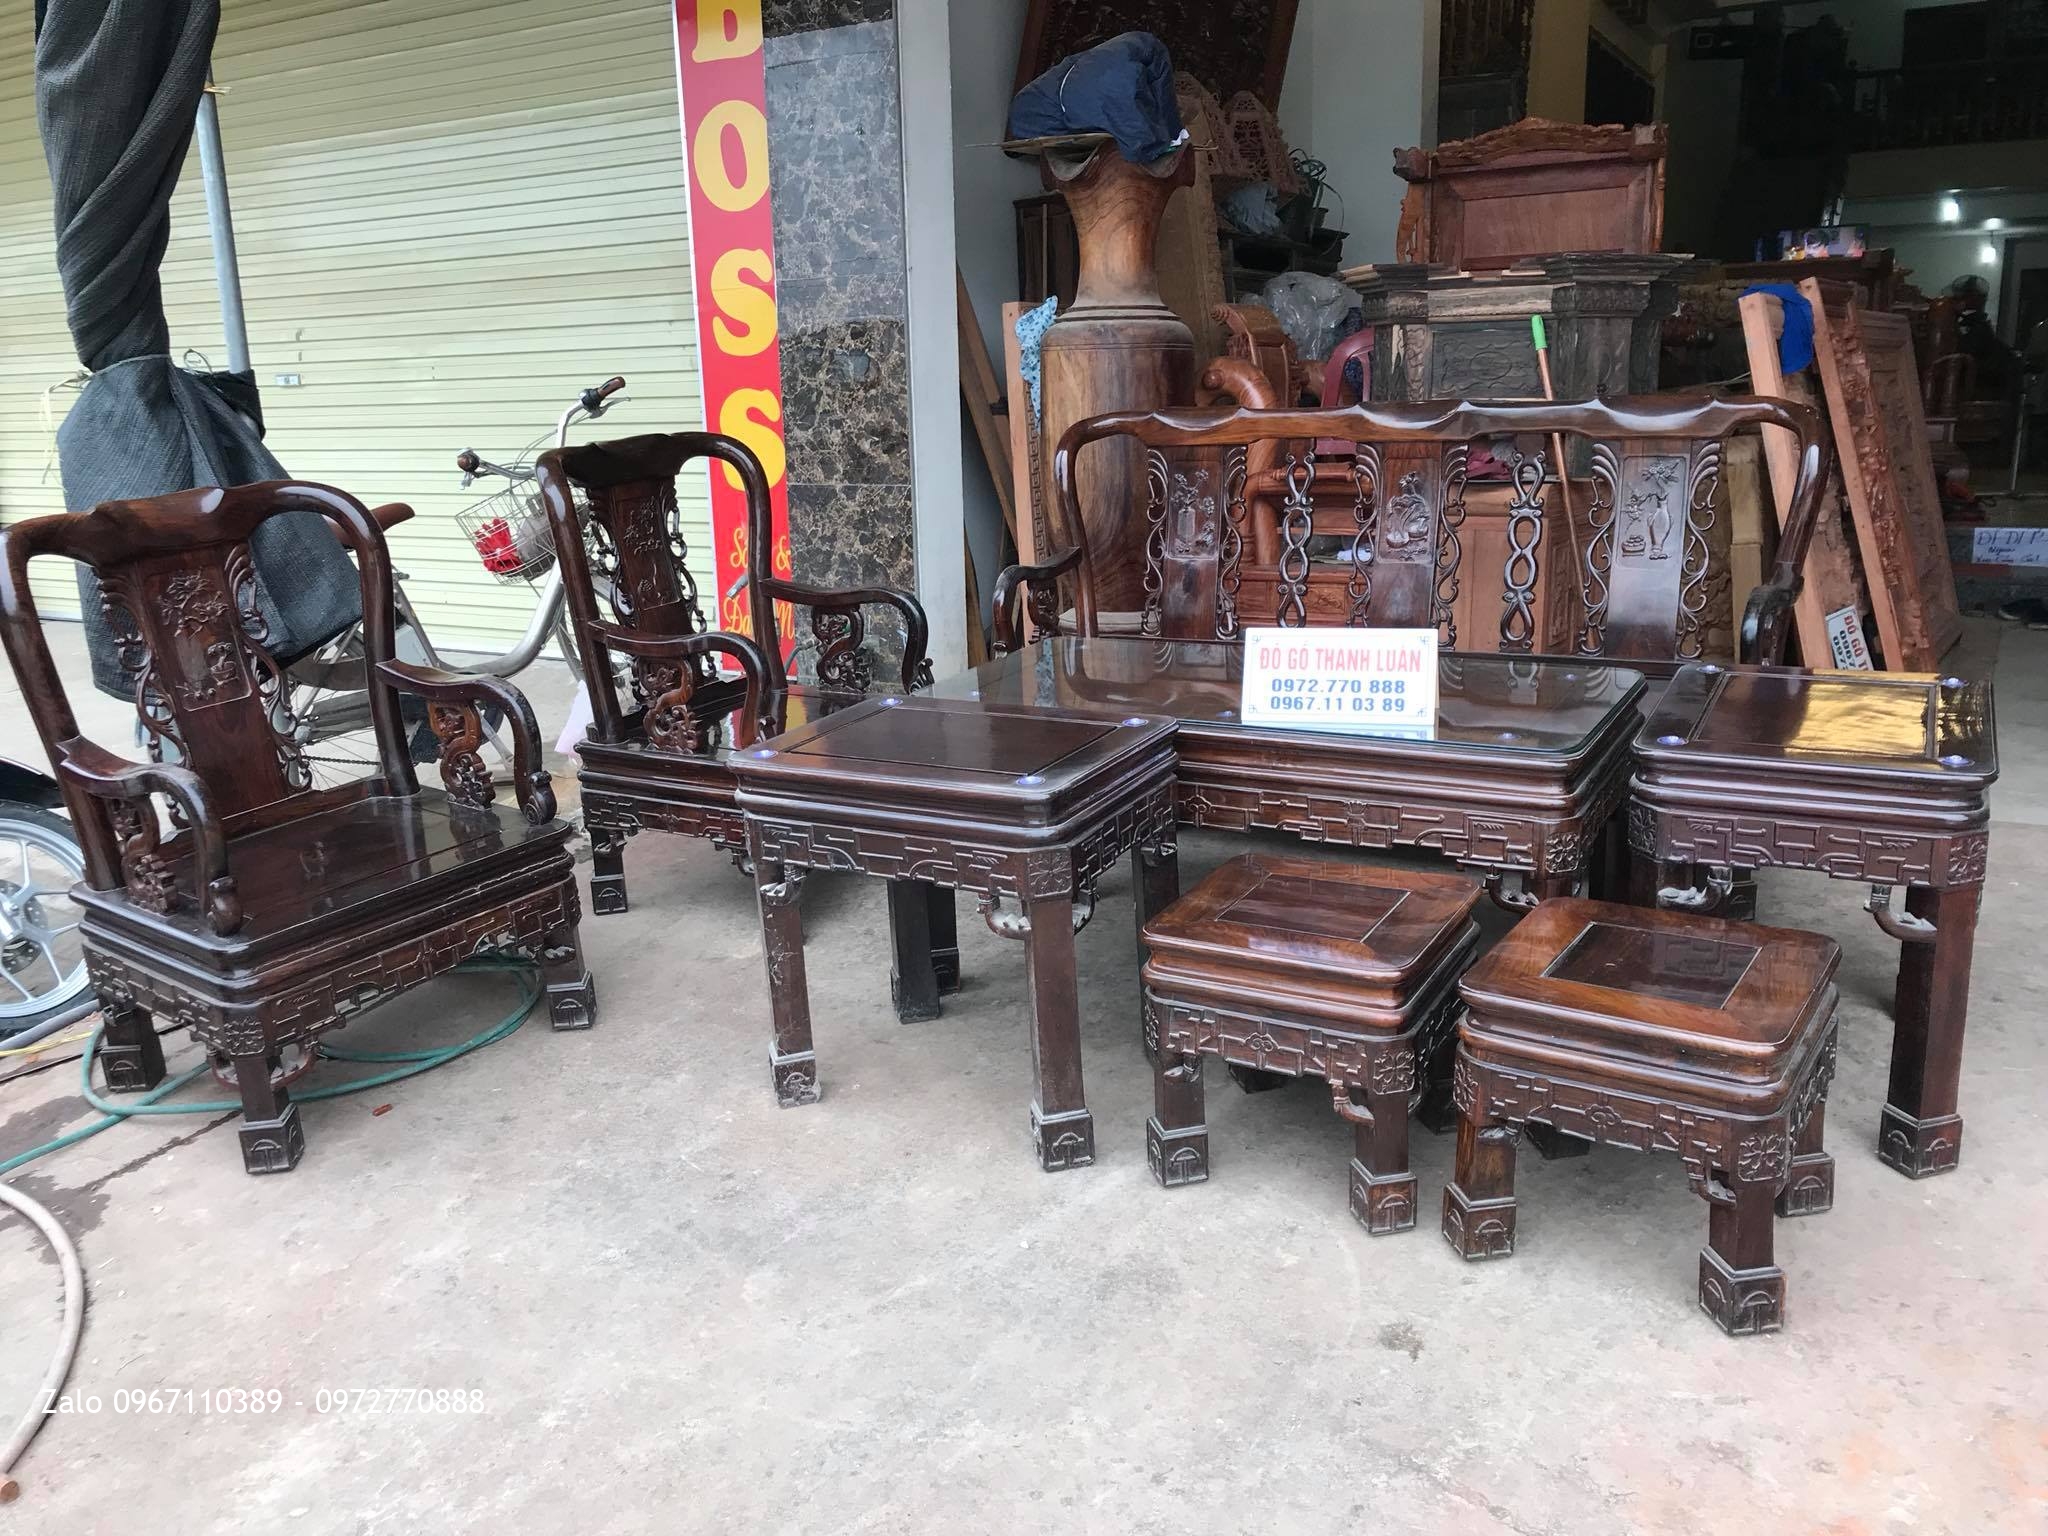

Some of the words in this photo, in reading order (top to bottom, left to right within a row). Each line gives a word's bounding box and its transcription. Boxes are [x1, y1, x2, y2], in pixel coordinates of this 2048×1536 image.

[1315, 647, 1371, 672] THANH
[1271, 678, 1362, 694] 0972.770
[1369, 679, 1406, 694] 888
[1270, 696, 1343, 711] 0967.11
[1352, 697, 1375, 712] 03
[1382, 698, 1406, 712] 89
